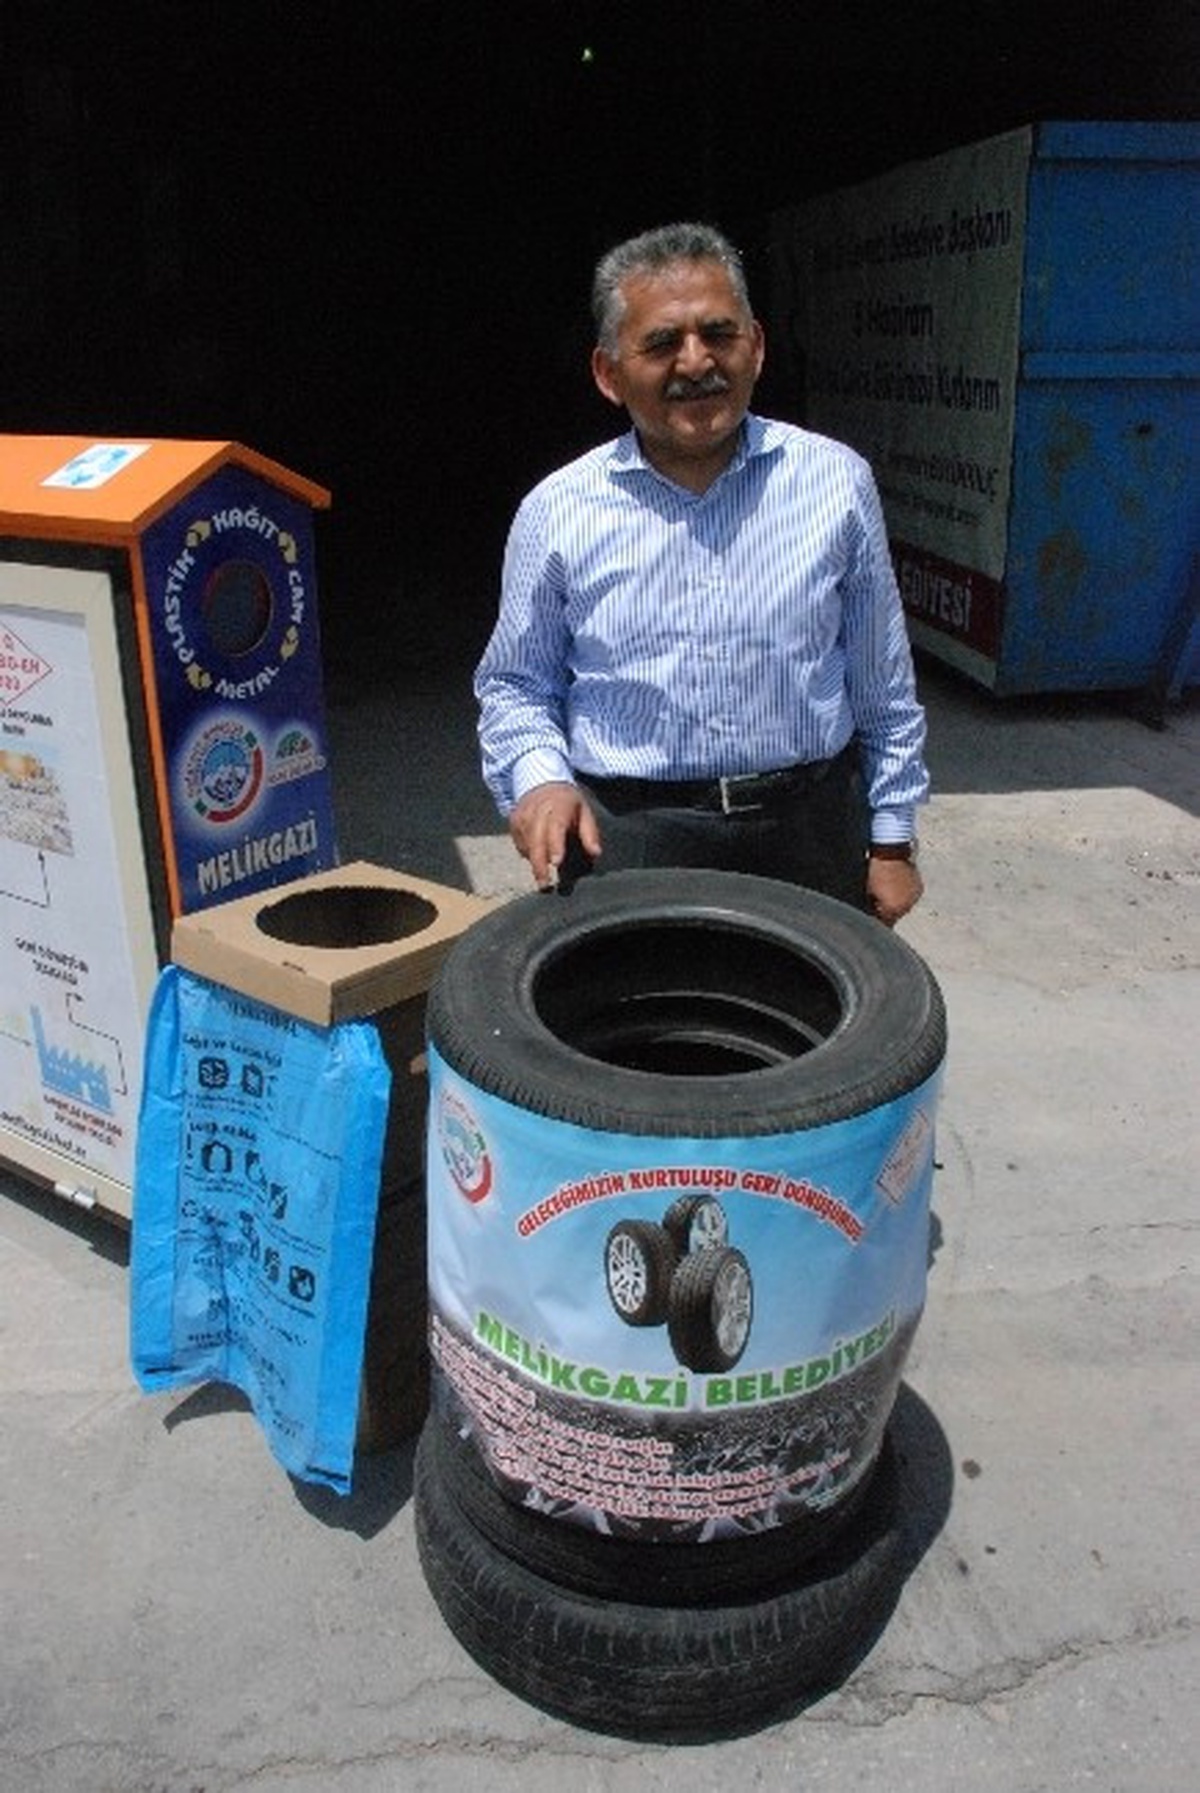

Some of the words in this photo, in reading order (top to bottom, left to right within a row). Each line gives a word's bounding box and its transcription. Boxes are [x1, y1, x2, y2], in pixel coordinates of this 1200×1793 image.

[212, 505, 280, 539] KAĞIT
[164, 548, 196, 663] PLASTİK
[288, 570, 304, 624] CAM
[214, 665, 280, 699] METAL
[197, 809, 318, 895] MELİKGAZİ
[517, 1170, 626, 1238] GELECEĞİMİZİN
[630, 1168, 737, 1193] KURTULUŞU
[740, 1169, 783, 1194] GERİ
[476, 1310, 689, 1408] MELİKGAZİ
[705, 1303, 896, 1408] BELEDİYESİ
